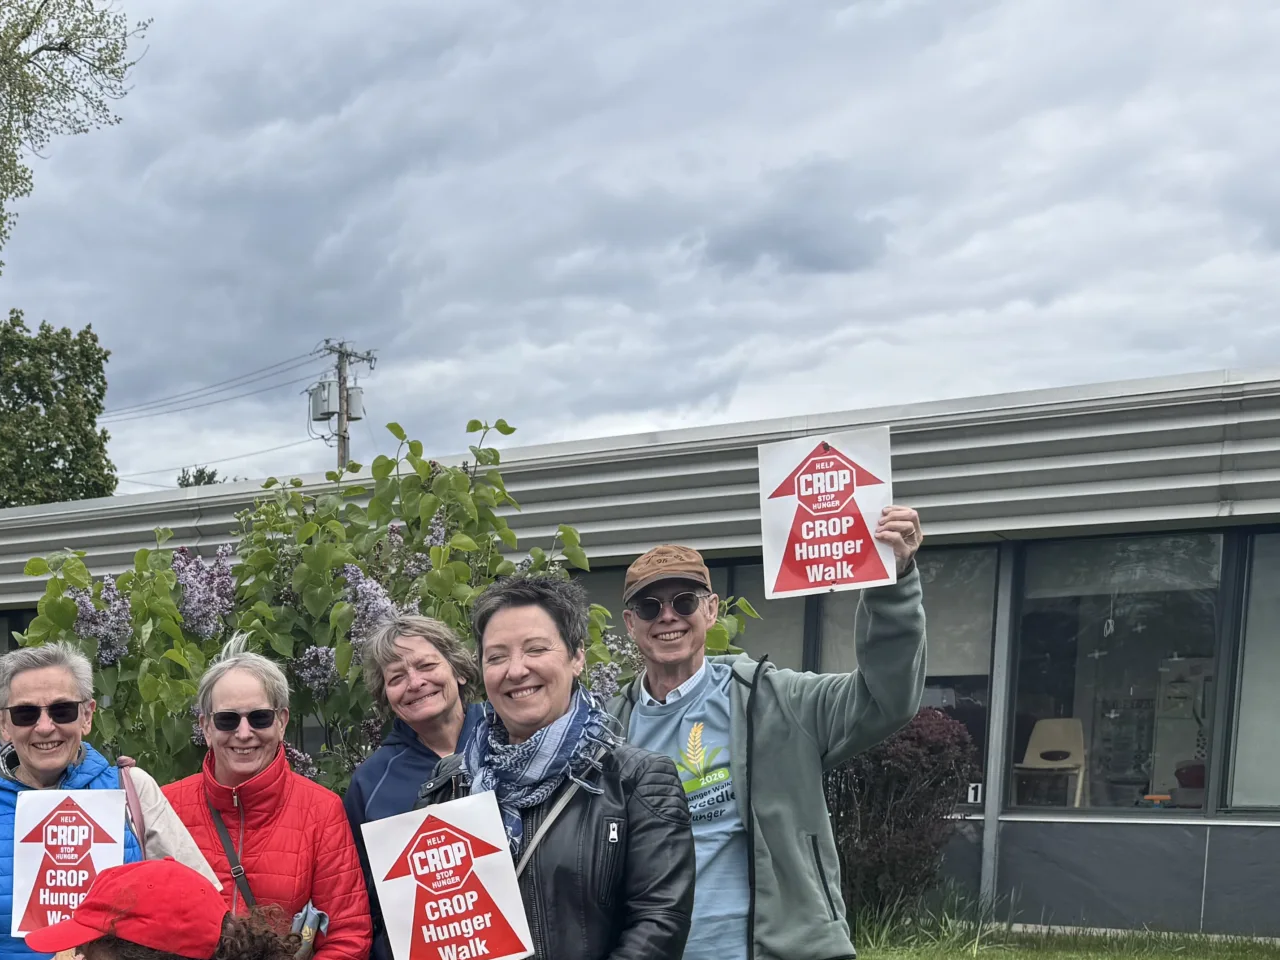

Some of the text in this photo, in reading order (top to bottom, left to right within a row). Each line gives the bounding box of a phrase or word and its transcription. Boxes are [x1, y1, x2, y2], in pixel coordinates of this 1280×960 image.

[816, 461, 834, 470] HELP
[800, 470, 850, 496] CROP
[813, 500, 840, 510] HUNGER
[818, 494, 835, 502] STOP
[802, 516, 854, 539] CROP
[794, 539, 863, 561] Hunger
[806, 561, 854, 583] Walk
[700, 771, 725, 786] 2026
[688, 790, 711, 801] unger
[972, 784, 978, 801] 1
[692, 809, 725, 822] unger
[47, 825, 89, 845] CROP
[426, 835, 446, 846] HELP
[412, 842, 467, 876] CROP
[46, 870, 89, 887] CROP
[432, 876, 460, 889] HUNGER
[436, 870, 454, 880] STOP
[40, 888, 87, 910] Hunge
[425, 890, 479, 922] CROP
[47, 911, 74, 926] Wa
[421, 912, 493, 943] Hunger
